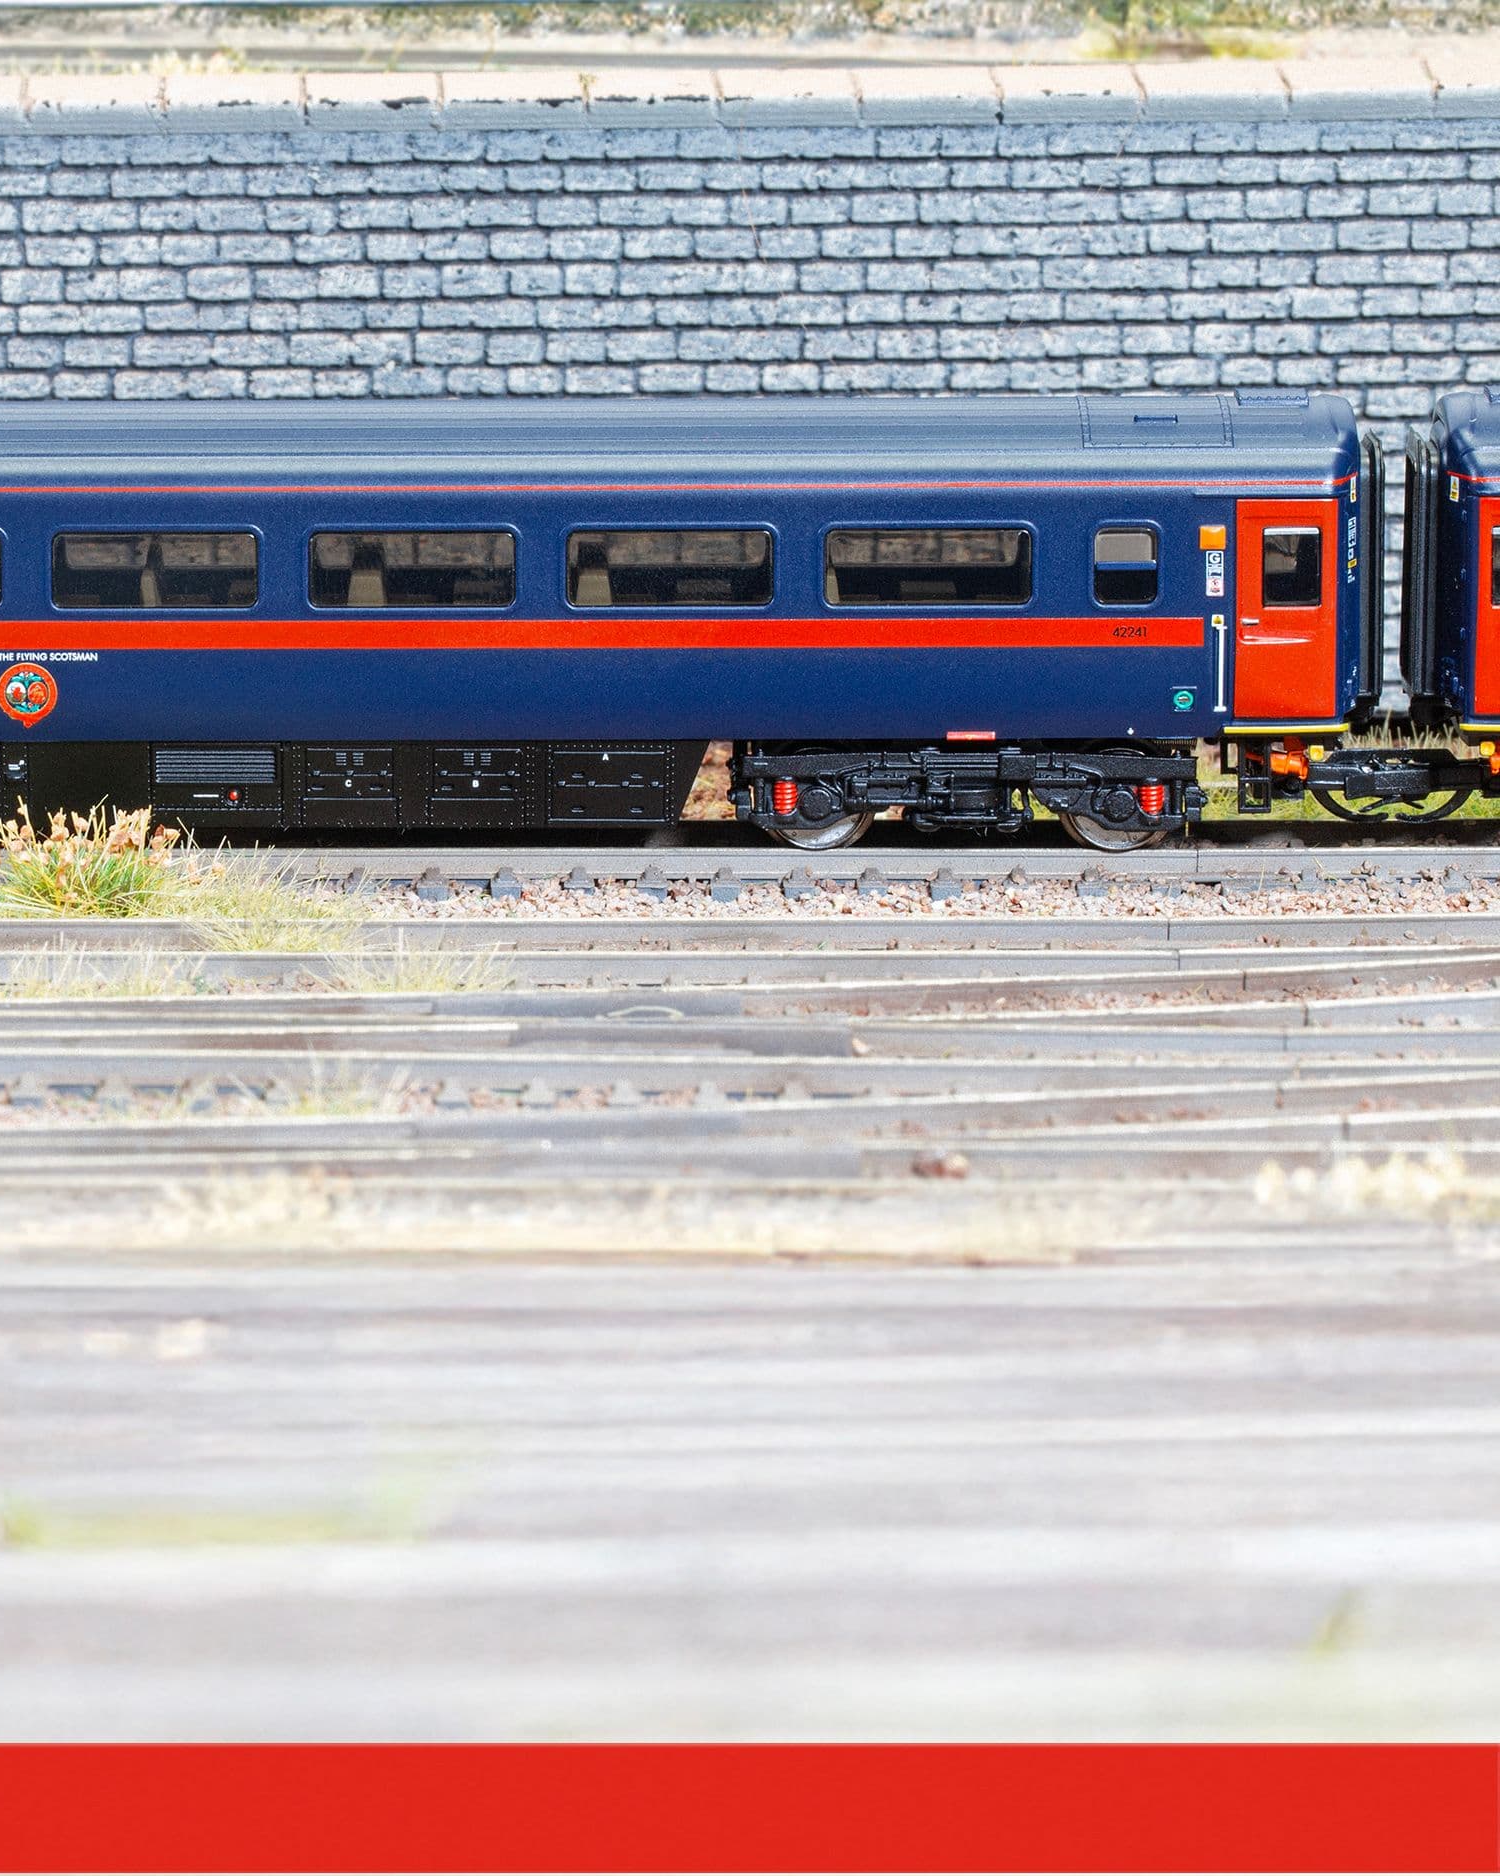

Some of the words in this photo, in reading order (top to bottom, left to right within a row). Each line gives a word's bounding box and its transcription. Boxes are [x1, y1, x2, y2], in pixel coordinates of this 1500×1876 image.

[1209, 553, 1220, 564] G
[1112, 626, 1147, 638] 42241
[16, 652, 48, 662] FLYING
[49, 652, 98, 662] SCOTSMAN
